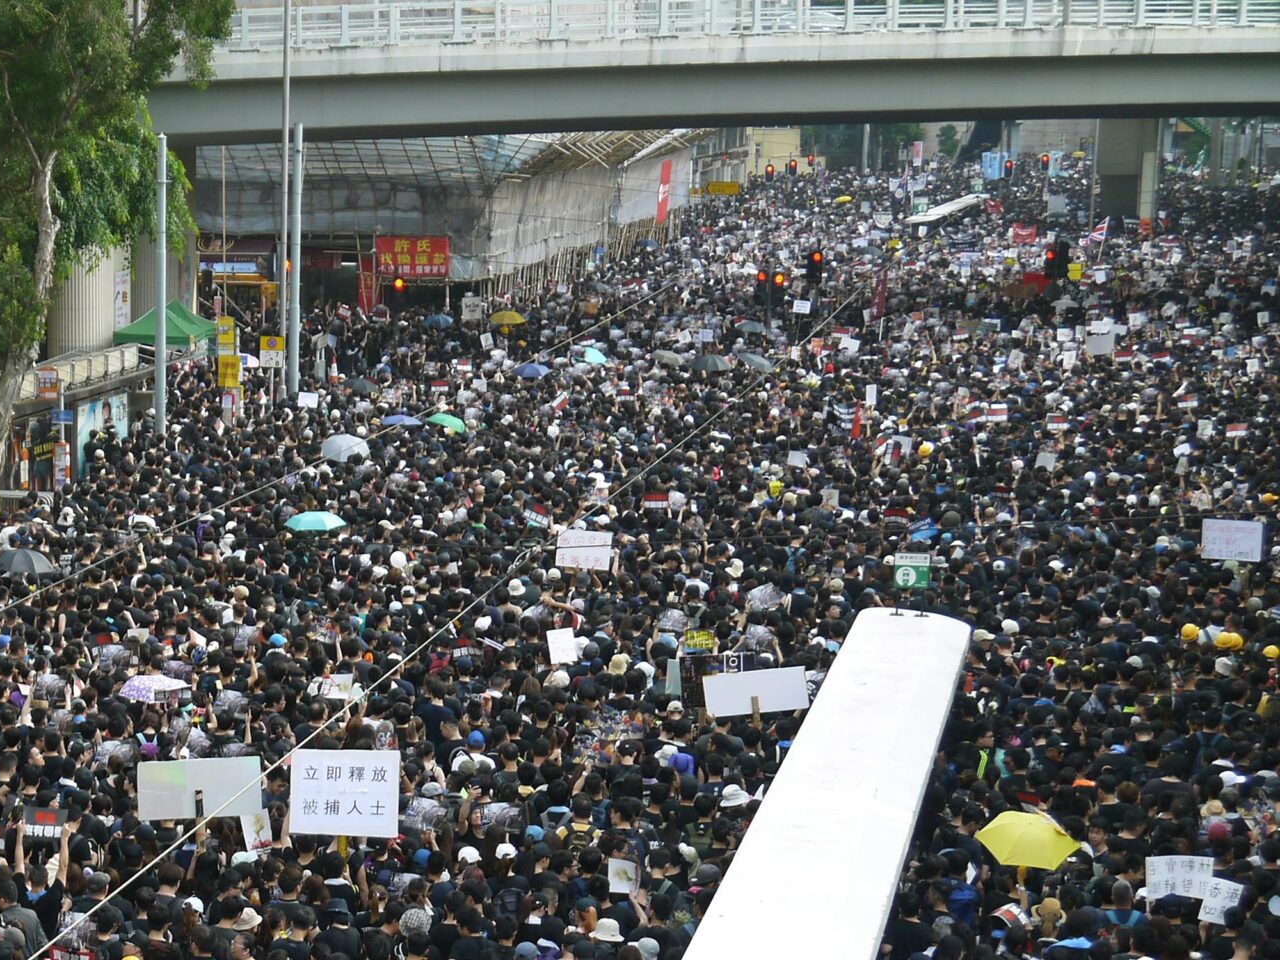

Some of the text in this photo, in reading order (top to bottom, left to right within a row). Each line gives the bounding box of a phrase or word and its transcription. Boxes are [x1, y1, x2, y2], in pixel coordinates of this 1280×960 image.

[302, 764, 388, 783] 立即釋放
[302, 798, 386, 816] 被捕人士
